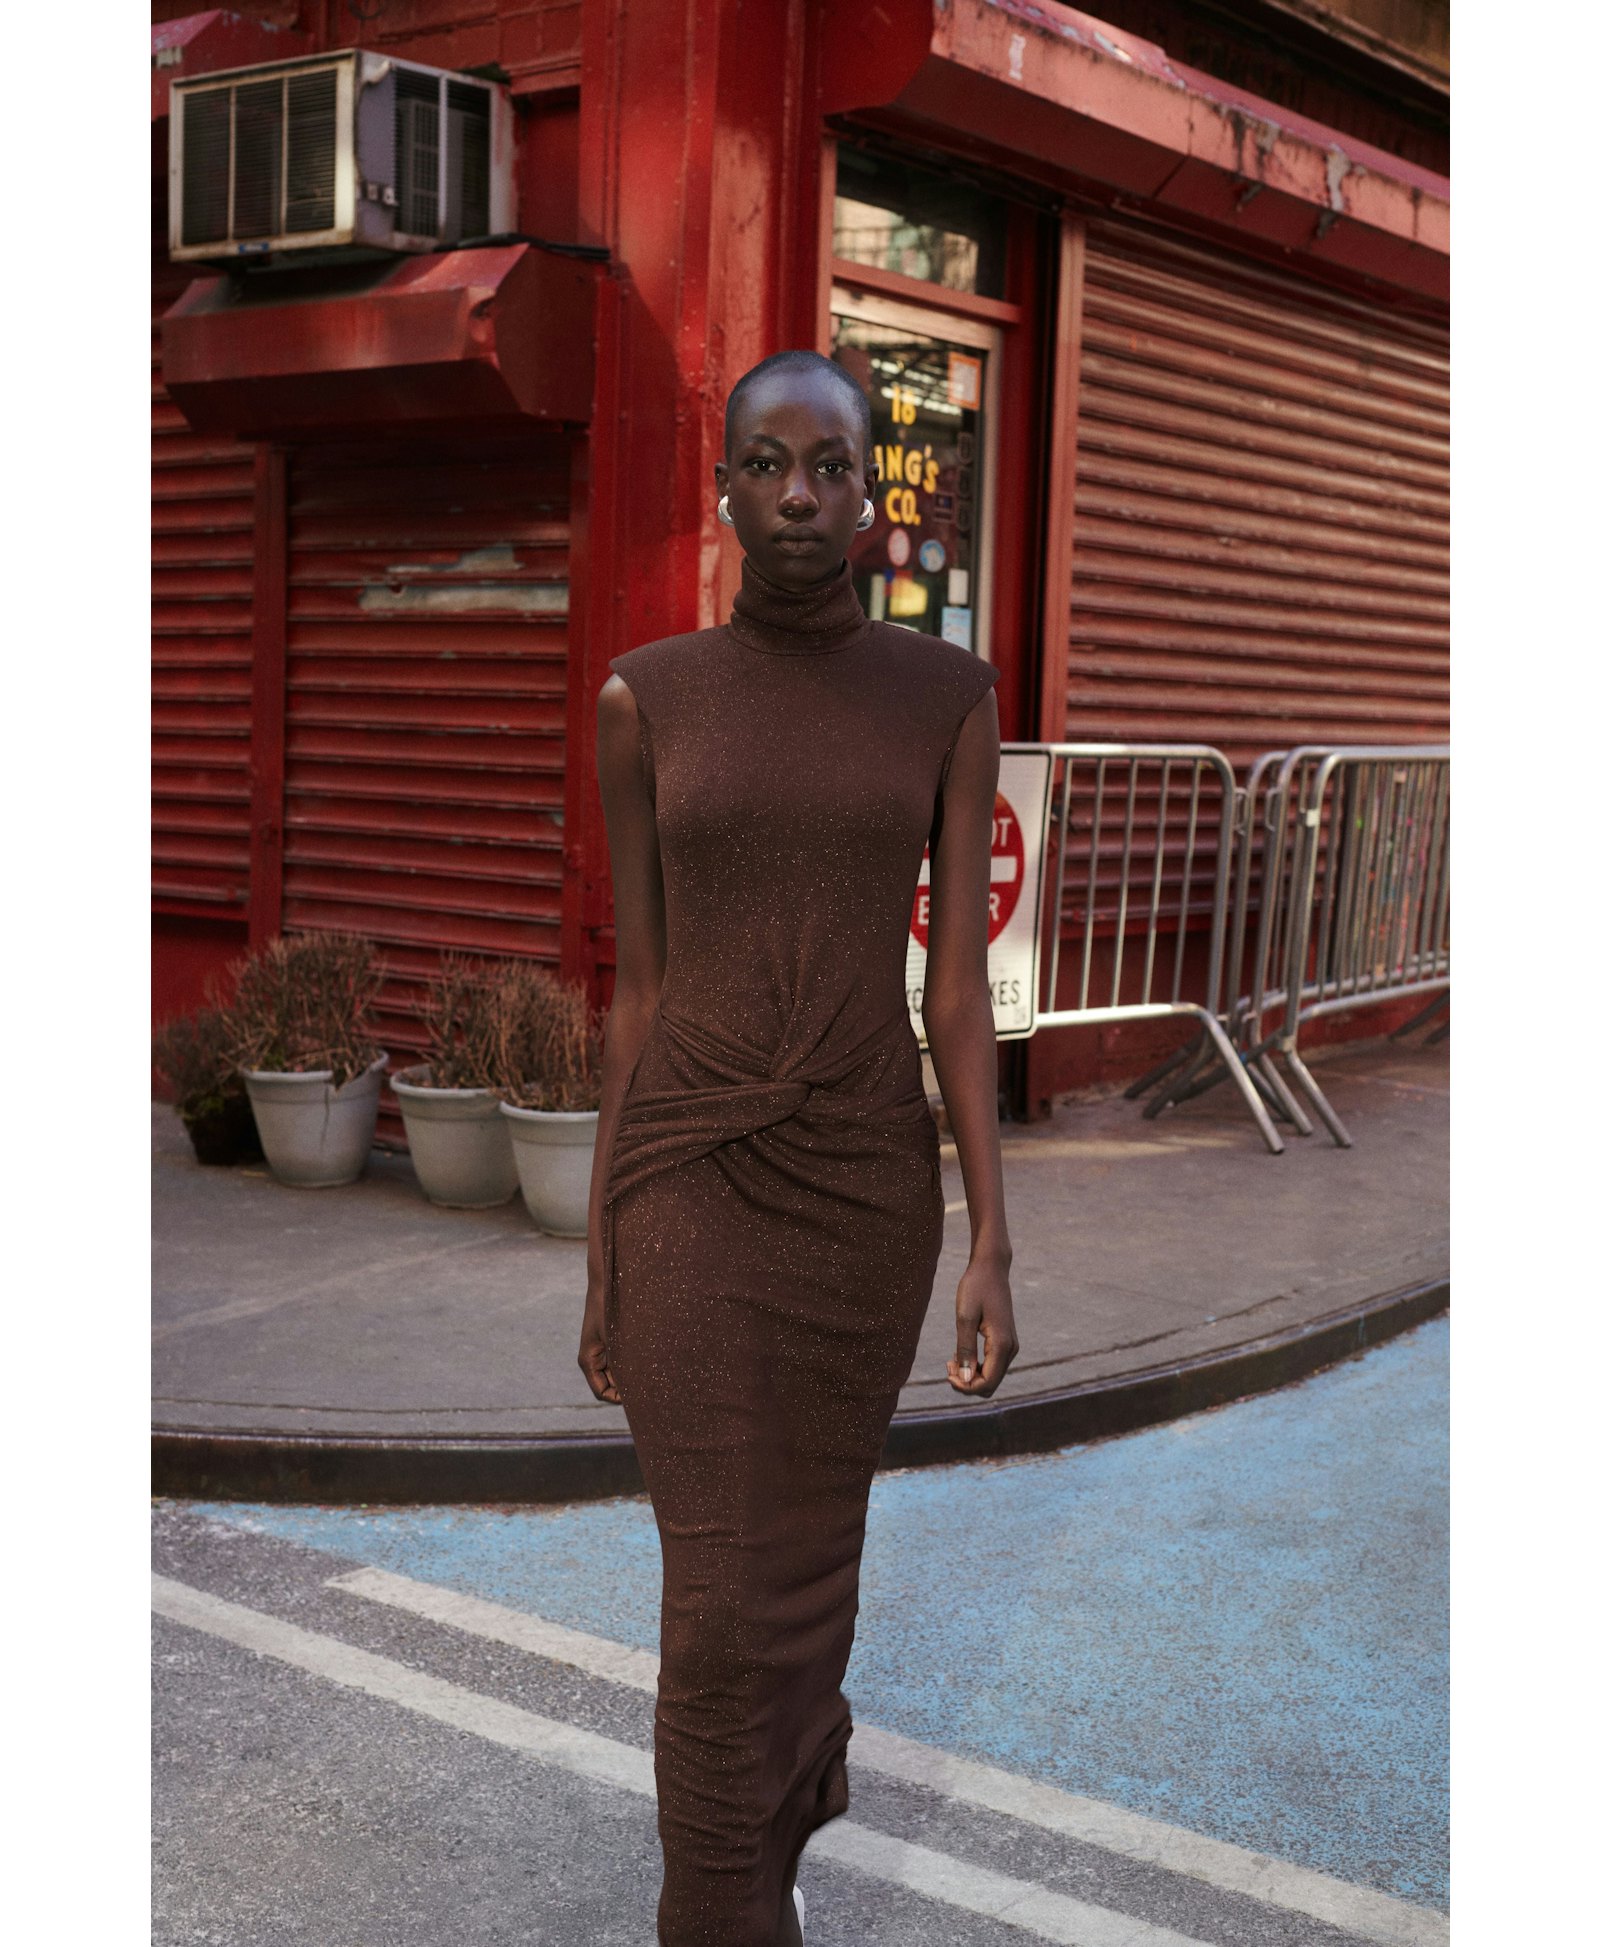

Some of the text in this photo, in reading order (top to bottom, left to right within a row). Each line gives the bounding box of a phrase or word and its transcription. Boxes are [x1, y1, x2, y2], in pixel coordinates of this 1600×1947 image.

[873, 444, 940, 494] ING'S
[885, 486, 921, 526] CO.
[989, 979, 1020, 1006] KES
